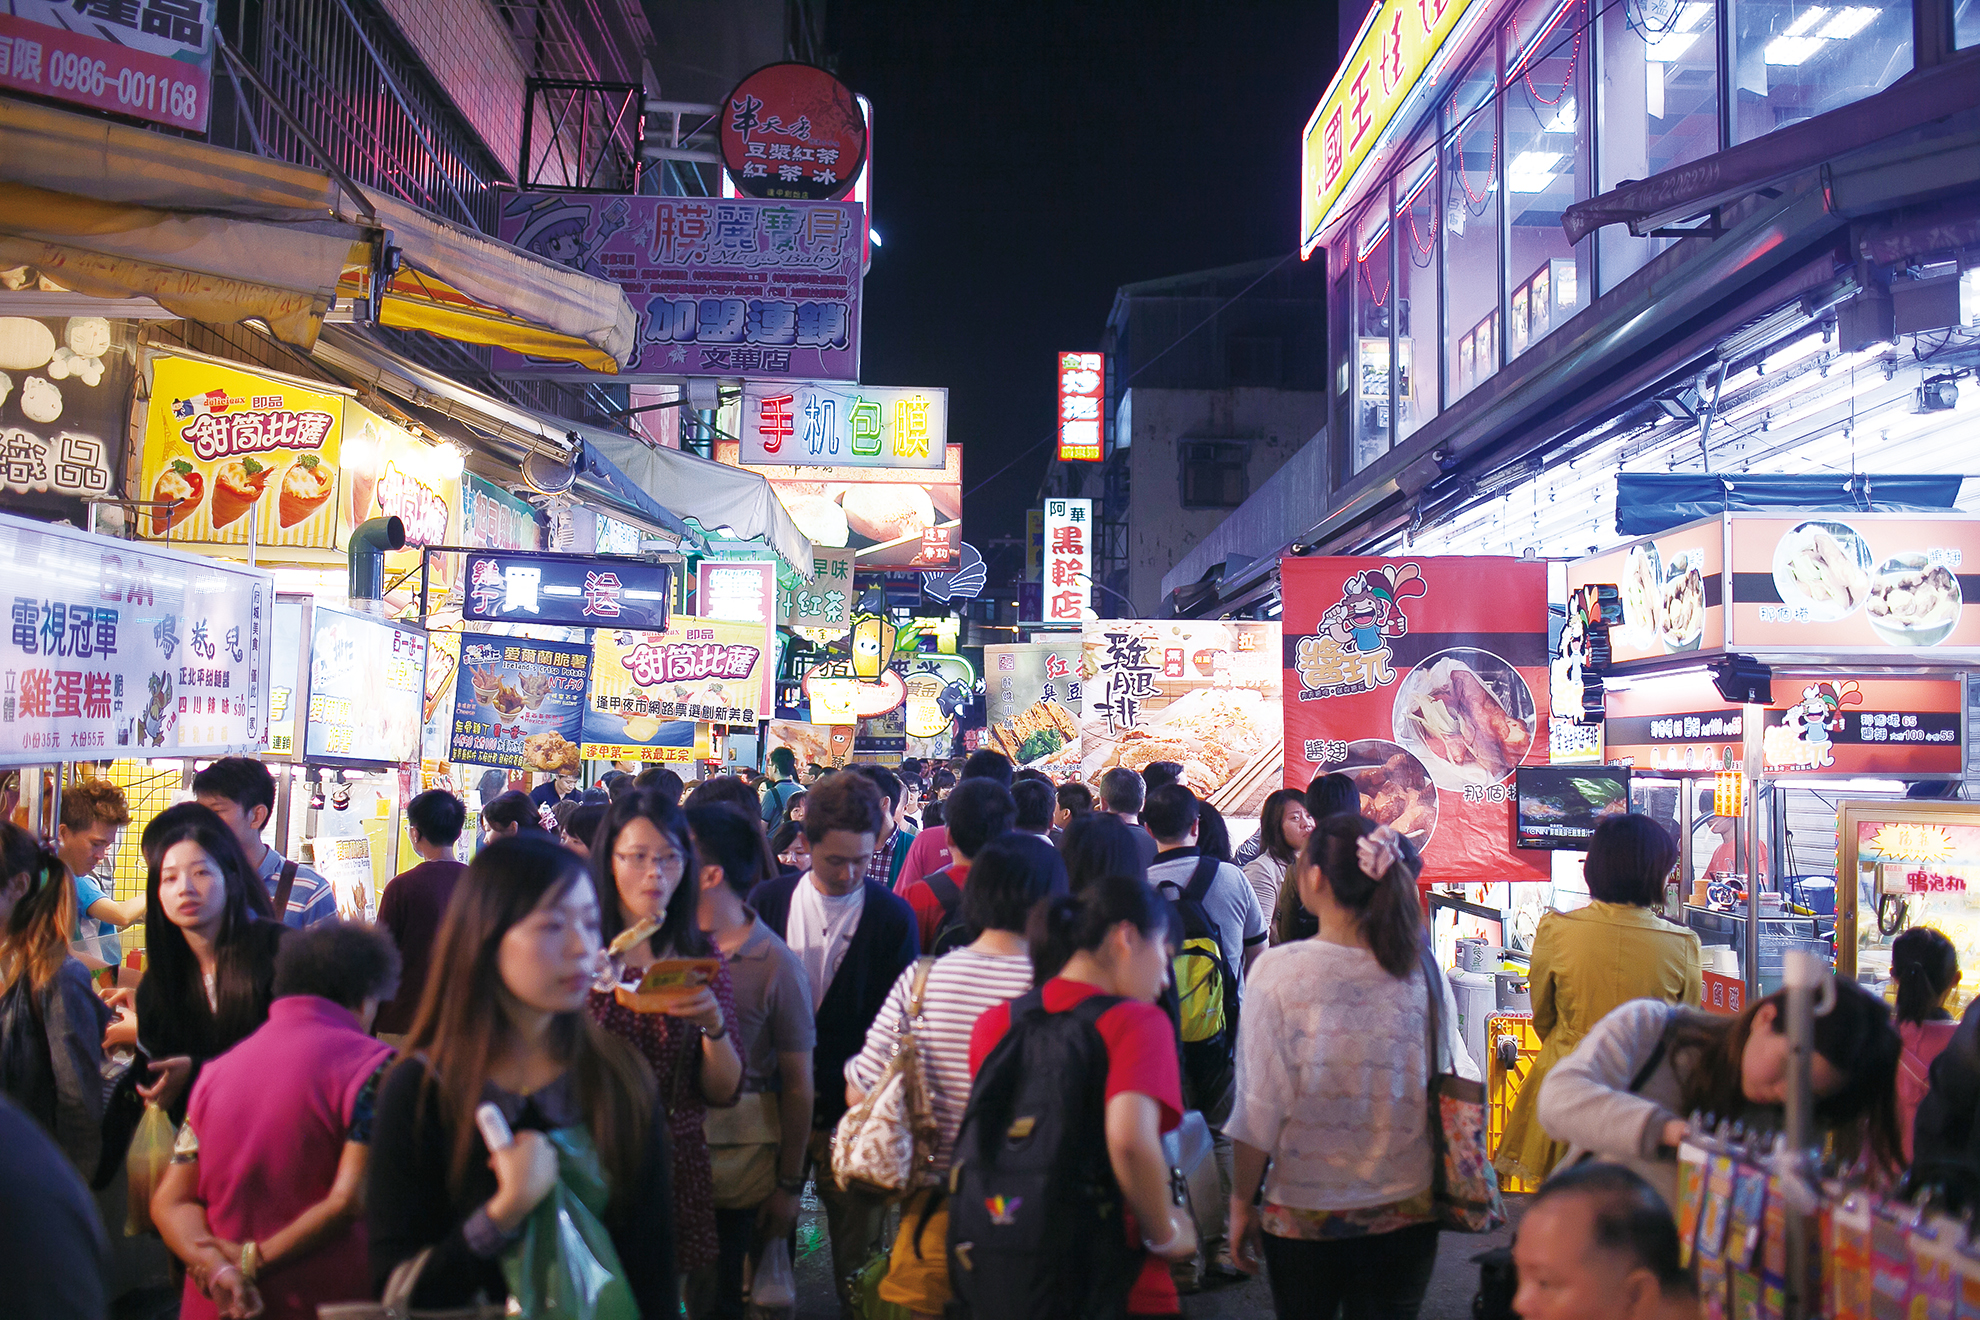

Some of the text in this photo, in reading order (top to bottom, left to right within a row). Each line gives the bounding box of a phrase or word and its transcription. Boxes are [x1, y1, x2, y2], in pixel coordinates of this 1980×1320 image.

[50, 50, 197, 120] 0986-001168
[743, 161, 837, 185] 紅茶冰
[745, 141, 839, 165] 豆漿紅茶
[647, 299, 849, 348] 加盟連鎖
[702, 350, 791, 371] 文華店
[253, 396, 283, 408] 即品
[181, 413, 332, 459] 甜筒比薩
[760, 395, 929, 457] 手机包膜
[1051, 526, 1083, 619] 黑輪店
[11, 597, 119, 660] 電視冠軍
[686, 629, 714, 640] 即品
[504, 646, 588, 669] 愛爾蘭脆薯
[622, 644, 759, 686] 甜筒比薩
[18, 668, 111, 719] 雞蛋糕
[596, 695, 754, 723] 逢甲夜市網路票選創新美食
